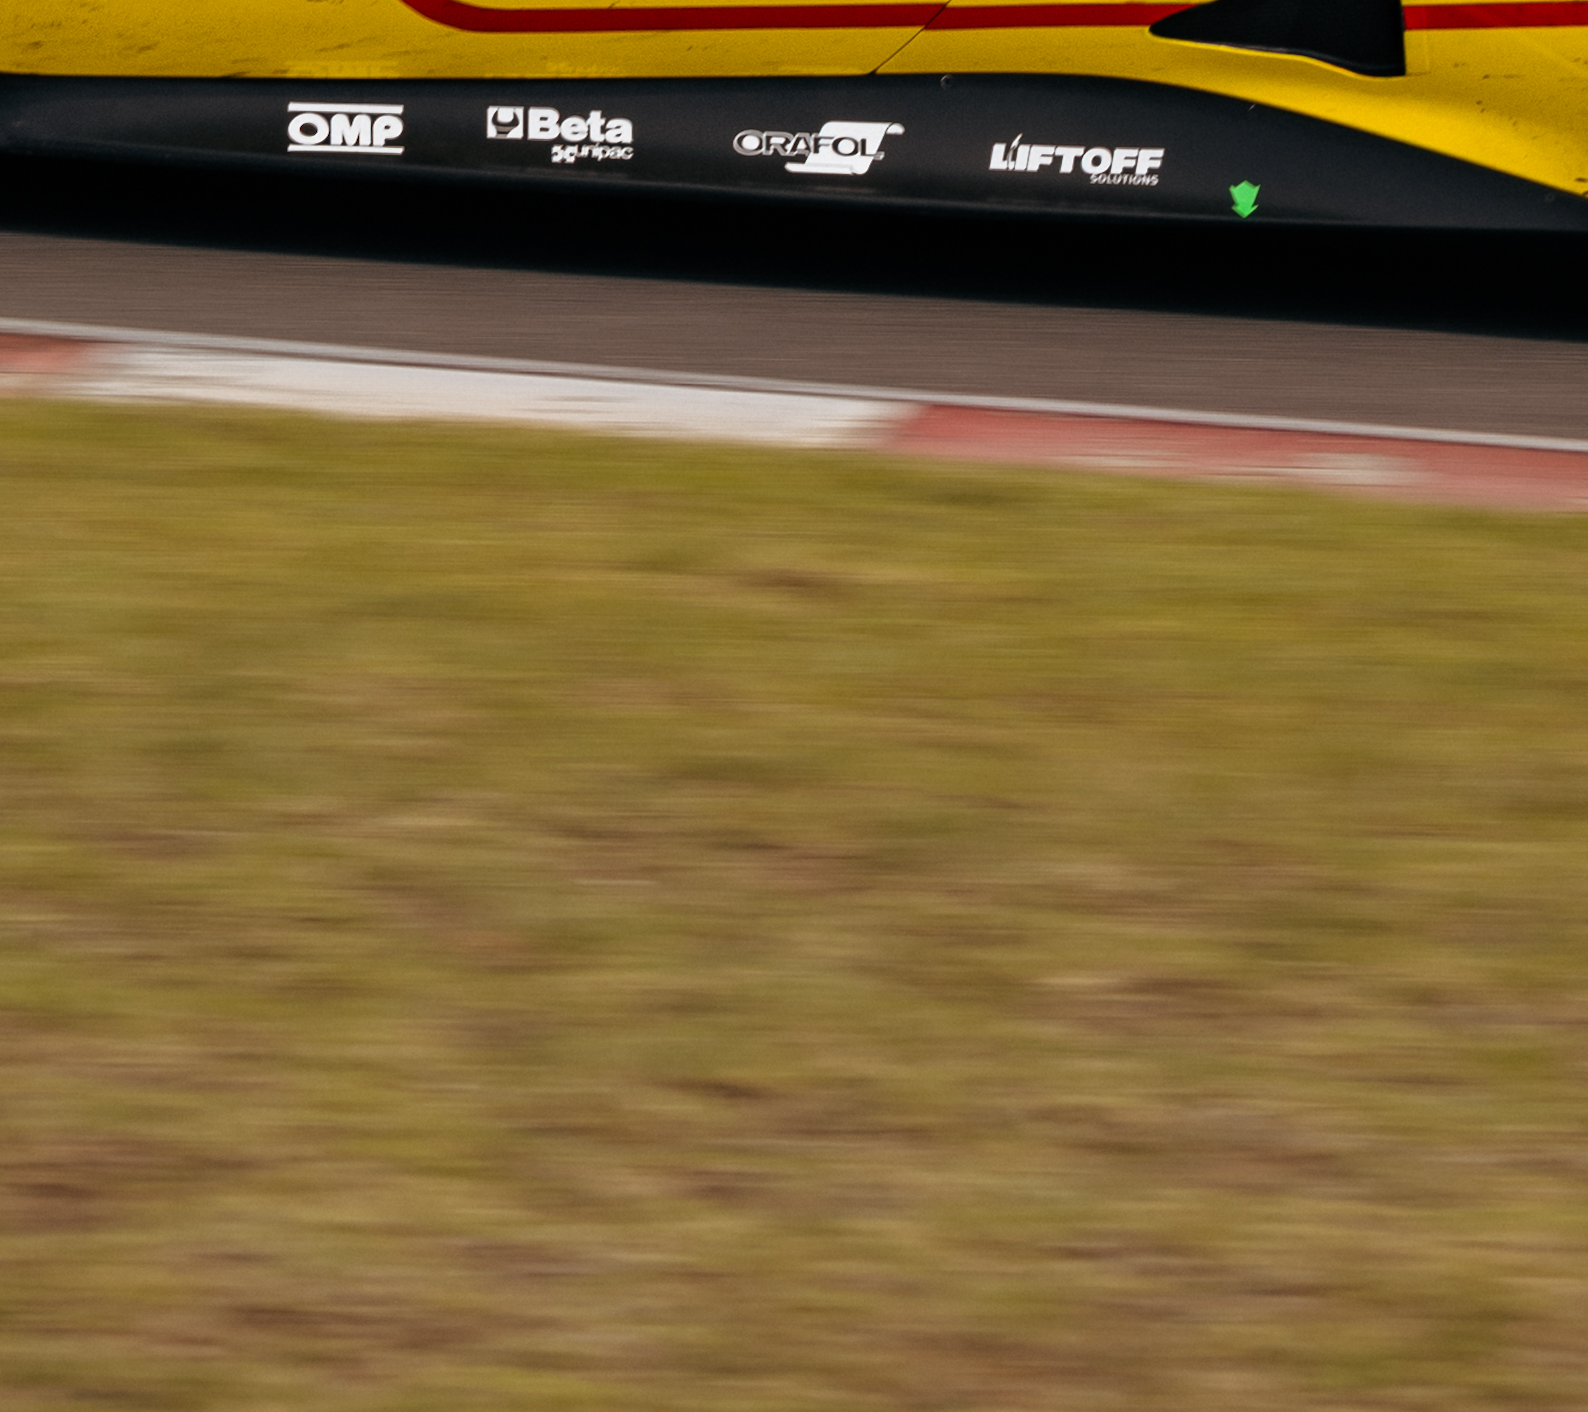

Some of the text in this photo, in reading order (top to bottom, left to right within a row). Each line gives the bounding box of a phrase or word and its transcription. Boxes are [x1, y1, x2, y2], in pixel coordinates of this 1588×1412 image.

[288, 113, 404, 146] OMP
[528, 106, 633, 144] Beta
[733, 129, 885, 160] ORAFOL
[989, 141, 1165, 175] LIFTOFF
[1090, 173, 1159, 187] SOLUTIONS
